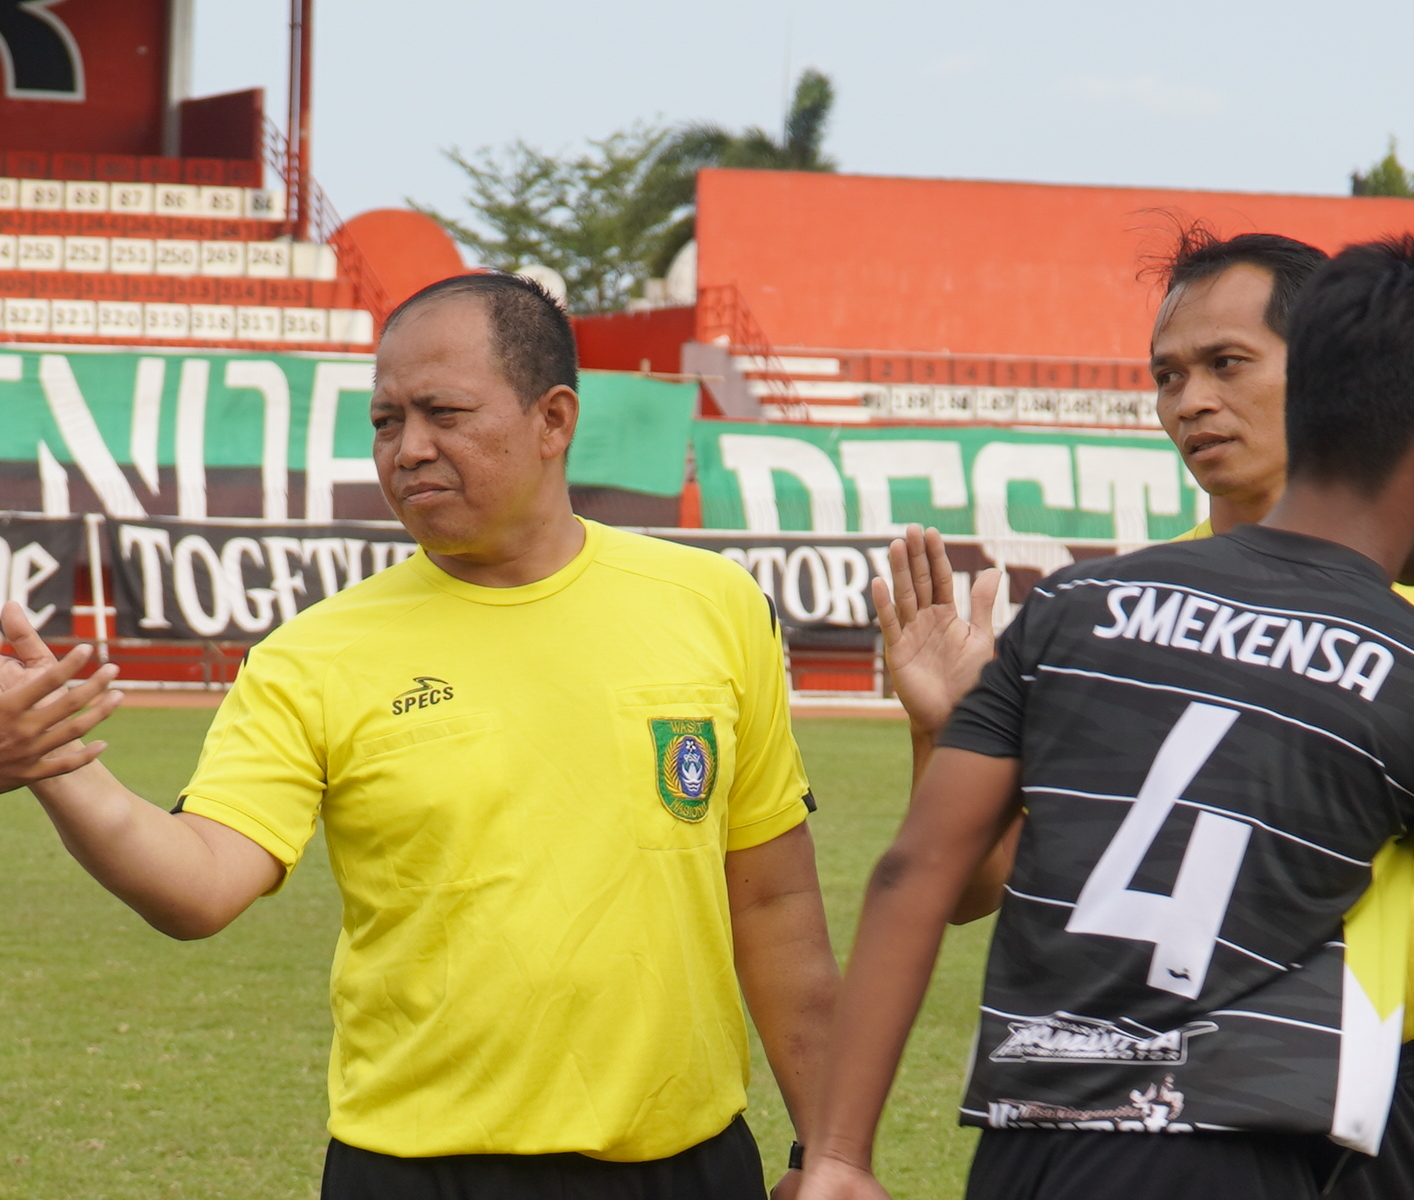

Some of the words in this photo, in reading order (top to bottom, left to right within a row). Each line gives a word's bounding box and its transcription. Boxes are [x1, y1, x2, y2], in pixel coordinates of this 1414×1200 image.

[34, 184, 58, 204] 89
[75, 185, 100, 205] 88
[120, 187, 143, 206] 87
[163, 188, 187, 208] 86
[212, 190, 234, 211] 85
[20, 242, 54, 260] 253
[68, 244, 101, 262] 252
[116, 246, 148, 264] 251
[159, 246, 193, 265] 250
[206, 246, 237, 265] 249
[55, 307, 91, 324] 321
[102, 307, 140, 327] 320
[149, 309, 182, 328] 319
[1093, 586, 1395, 702] SMEKENSA
[391, 685, 455, 717] SPECS
[669, 720, 704, 734] WASIT
[1064, 700, 1254, 1000] 4
